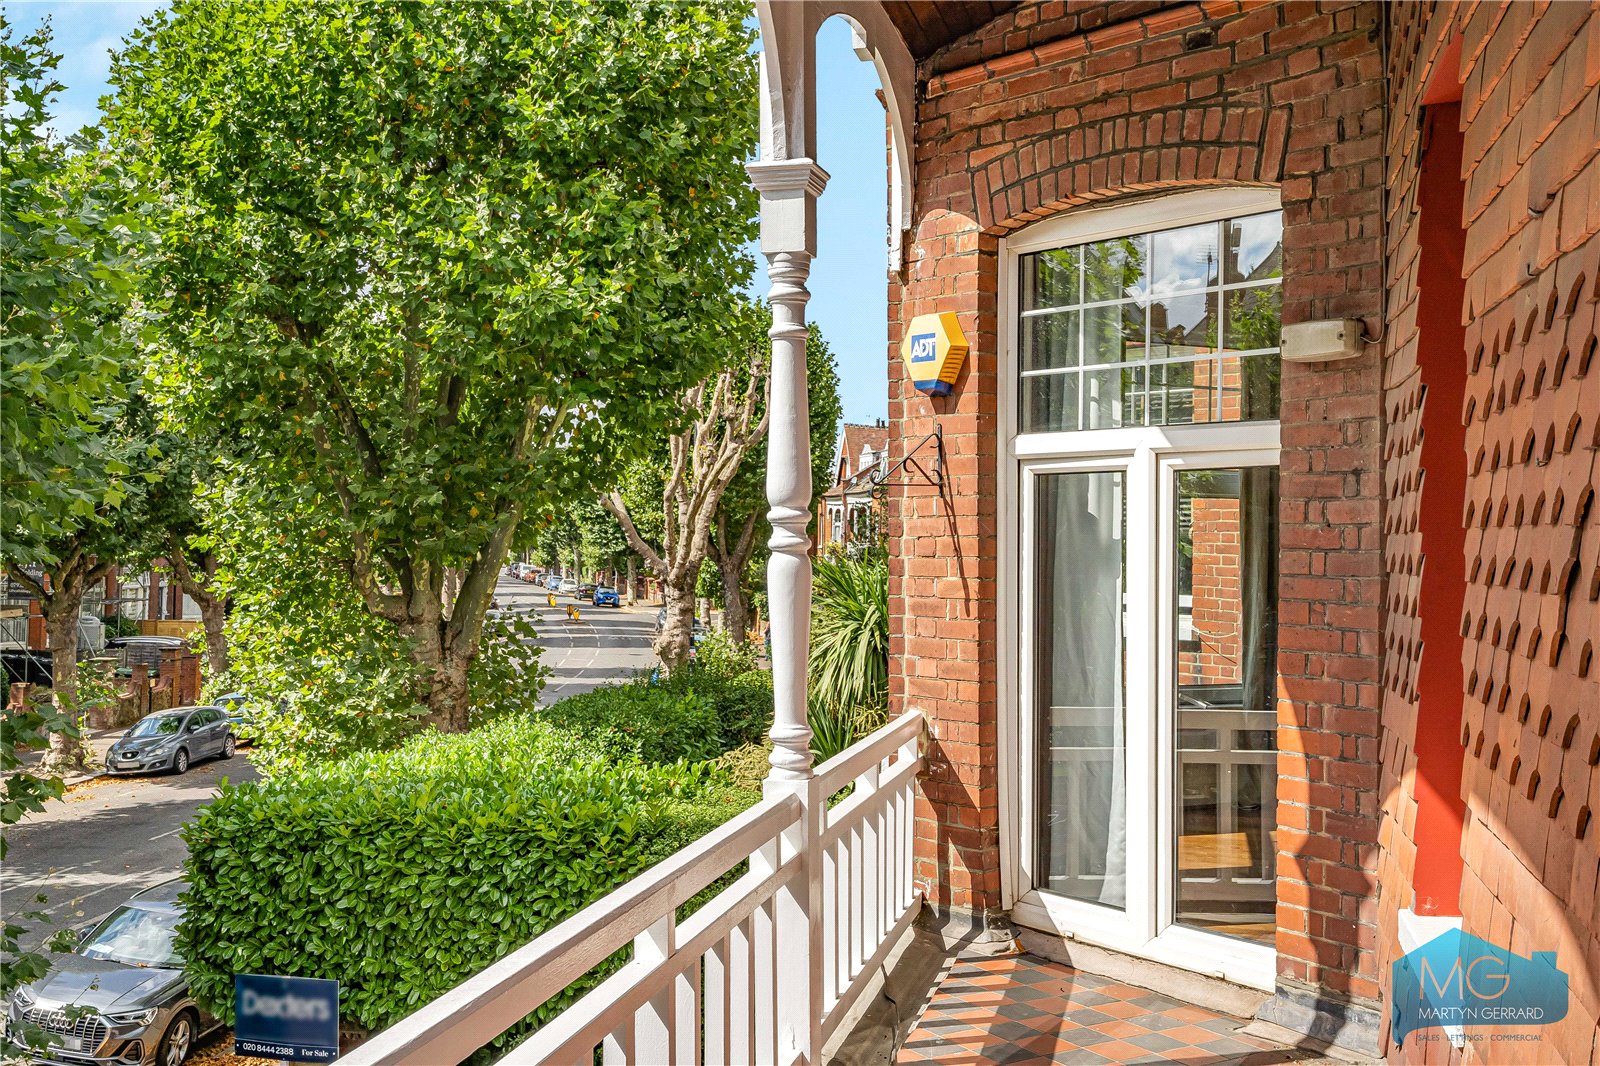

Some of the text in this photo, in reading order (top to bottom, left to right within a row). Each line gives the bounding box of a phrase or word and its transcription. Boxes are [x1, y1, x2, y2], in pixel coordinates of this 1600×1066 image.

[911, 337, 936, 359] ADT
[242, 1042, 294, 1056] 020 8444 2388
[301, 1048, 329, 1058] For Sale
